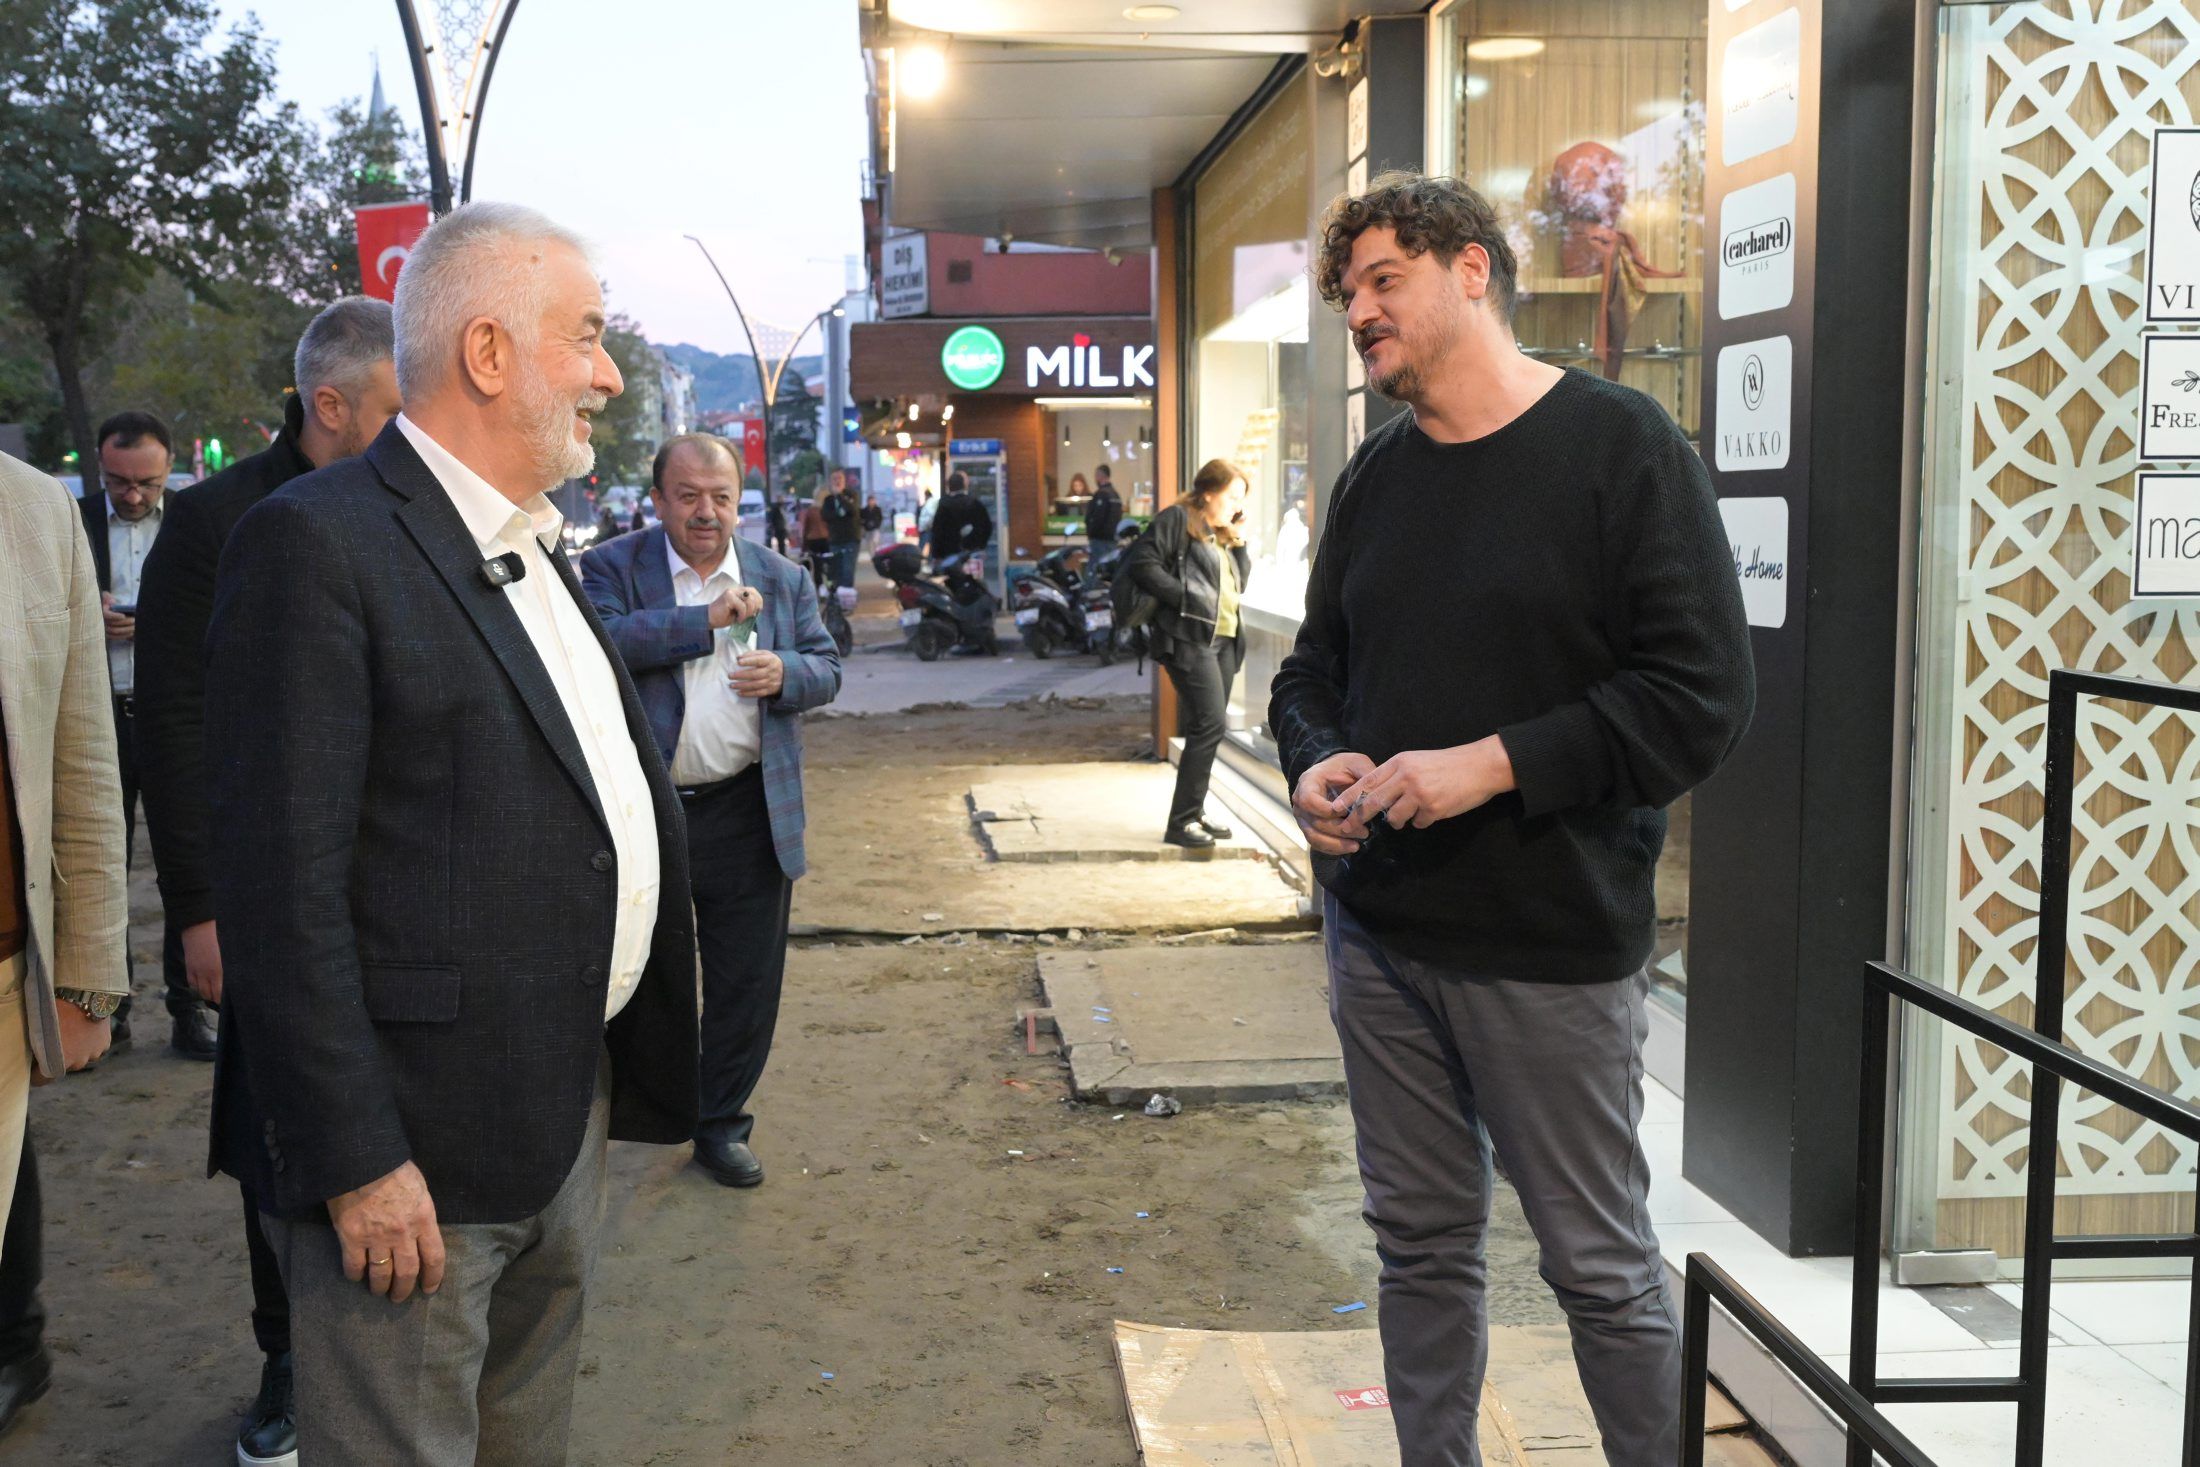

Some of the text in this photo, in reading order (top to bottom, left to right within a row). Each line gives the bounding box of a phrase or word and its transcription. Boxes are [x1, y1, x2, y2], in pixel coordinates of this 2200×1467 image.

[1729, 222, 1784, 260] cacharel
[1742, 260, 1769, 276] PARIS
[2150, 404, 2200, 428] FRE
[1724, 431, 1780, 457] VAKKO
[1745, 545, 1783, 580] Home
